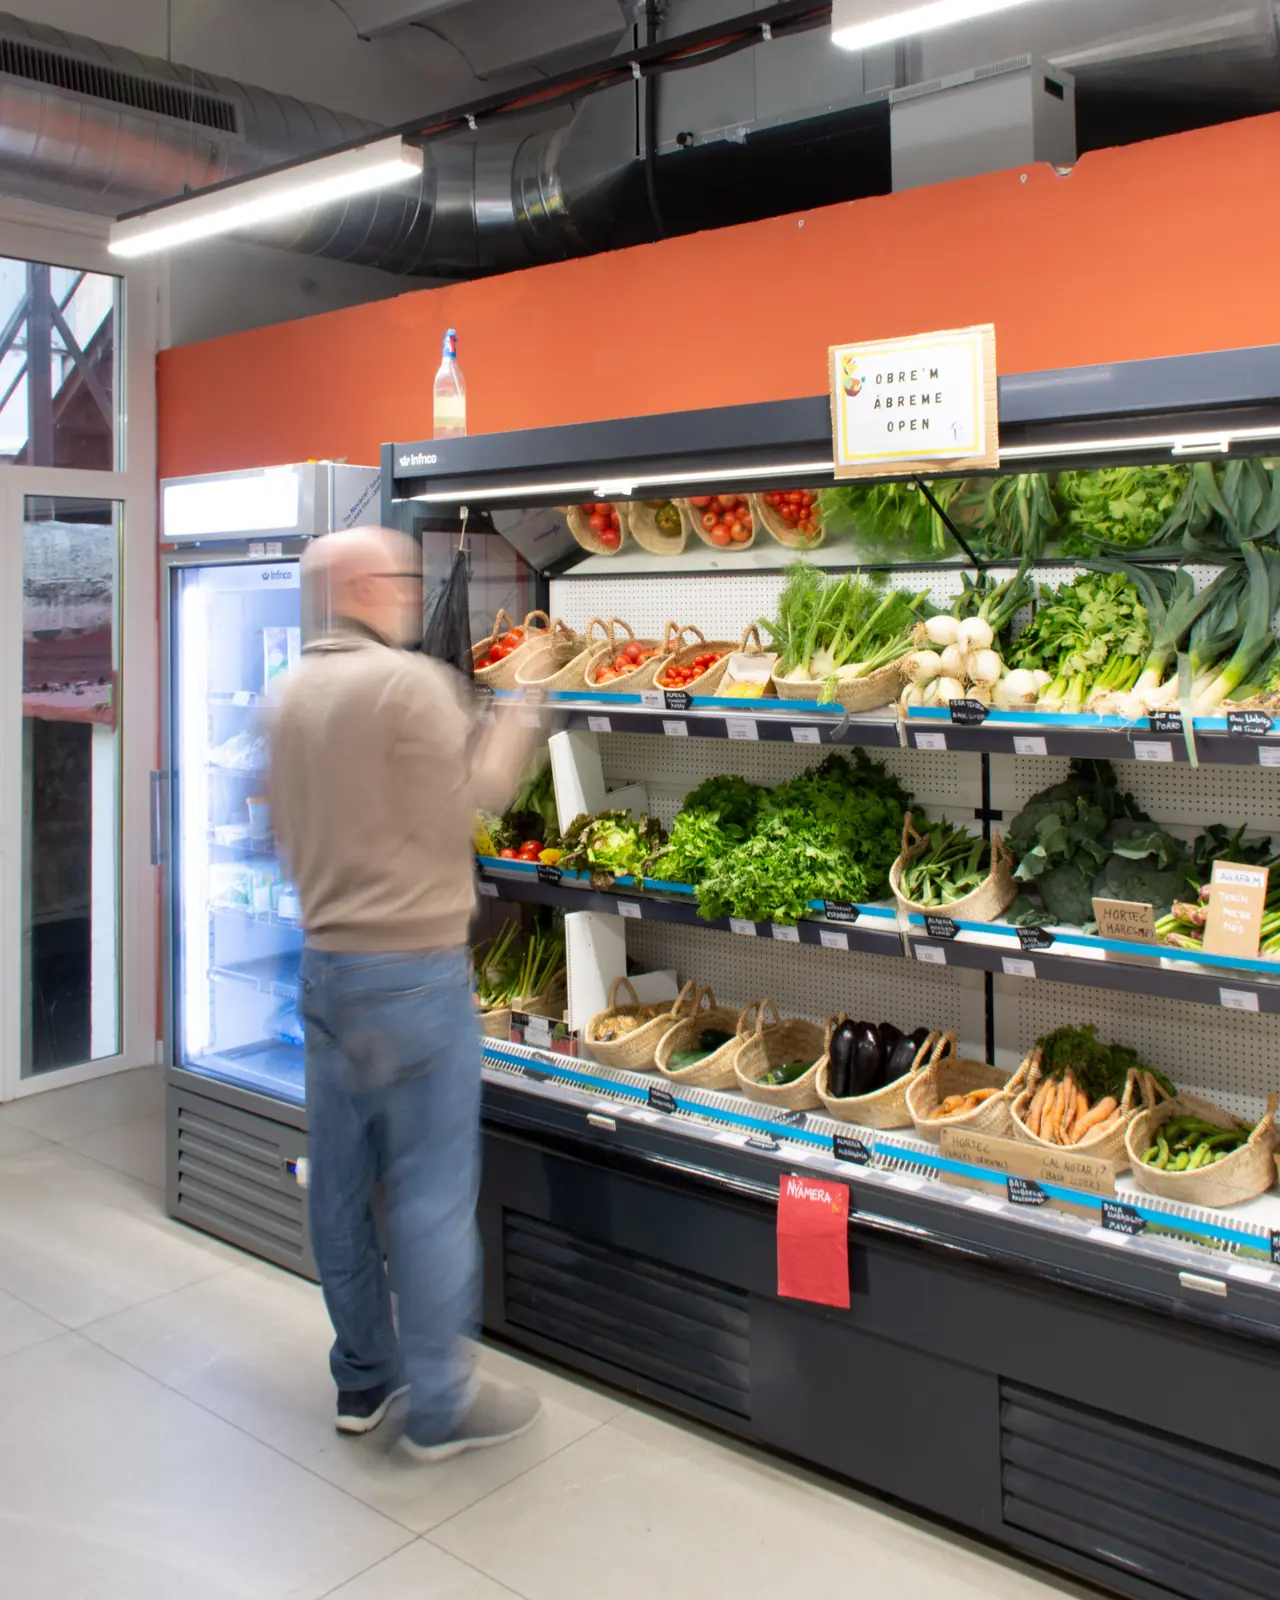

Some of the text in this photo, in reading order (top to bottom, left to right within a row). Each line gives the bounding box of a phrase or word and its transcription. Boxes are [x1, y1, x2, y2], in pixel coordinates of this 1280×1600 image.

[875, 368, 939, 385] OBRE'M
[873, 392, 943, 410] ÁBREME
[886, 418, 930, 433] OPEN
[410, 453, 438, 466] Infrico
[270, 570, 292, 580] Infrico
